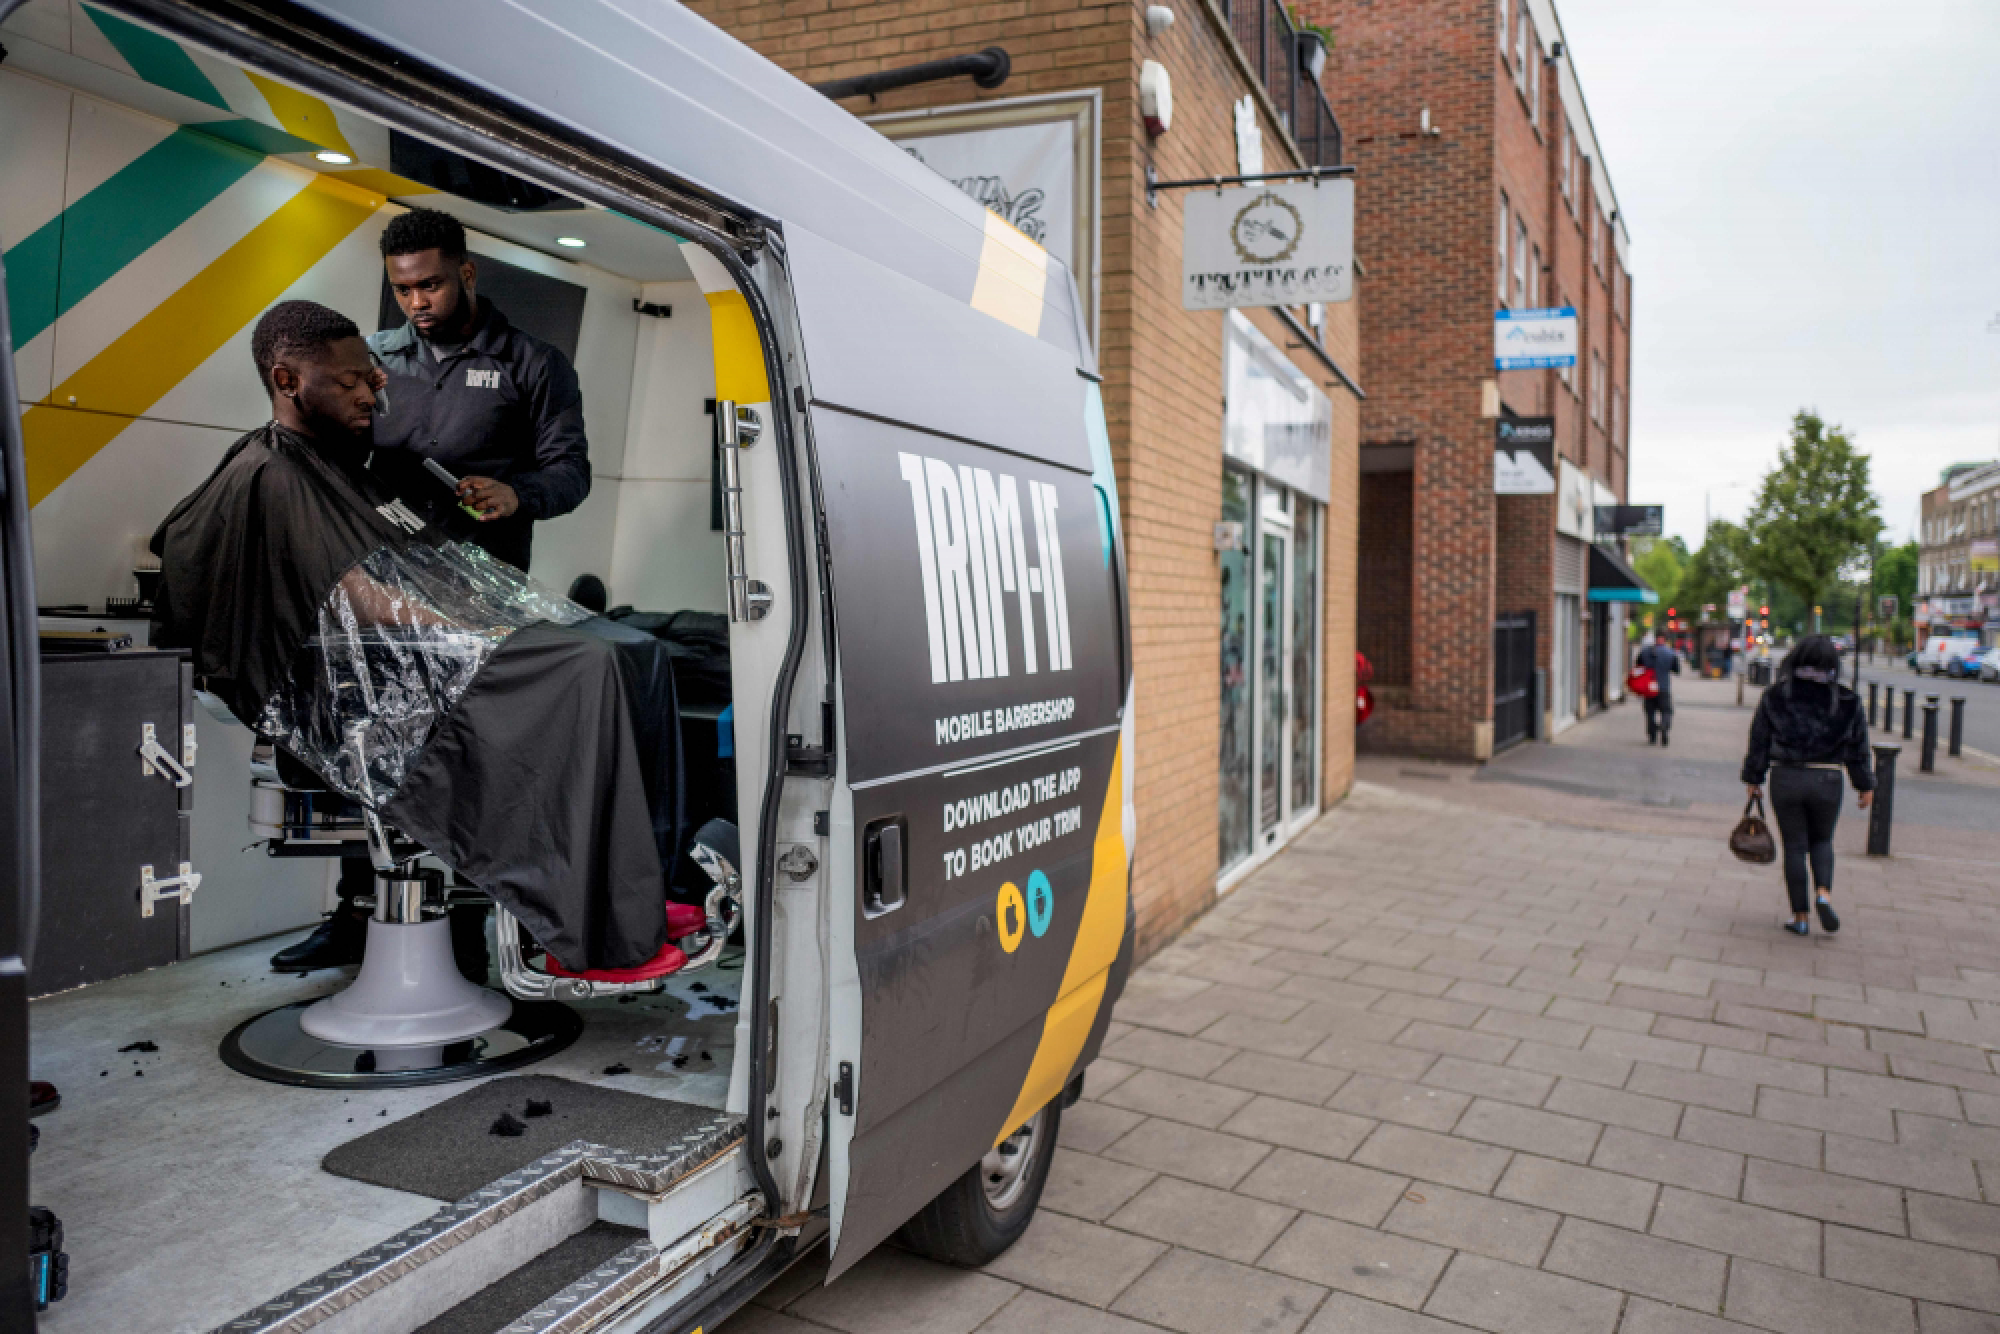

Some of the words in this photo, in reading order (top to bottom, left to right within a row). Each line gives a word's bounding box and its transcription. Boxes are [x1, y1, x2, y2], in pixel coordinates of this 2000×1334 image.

[898, 451, 1072, 684] TRIM-IT
[935, 710, 993, 746] MOBILE
[996, 696, 1075, 733] BARBERSHOP
[943, 782, 1030, 832] DOWNLOAD
[1032, 774, 1057, 804] THE
[1058, 766, 1081, 796] APP
[943, 848, 966, 880] TO
[971, 830, 1013, 872] BOOK
[1016, 817, 1051, 853] YOUR
[1053, 806, 1081, 837] TRIM
